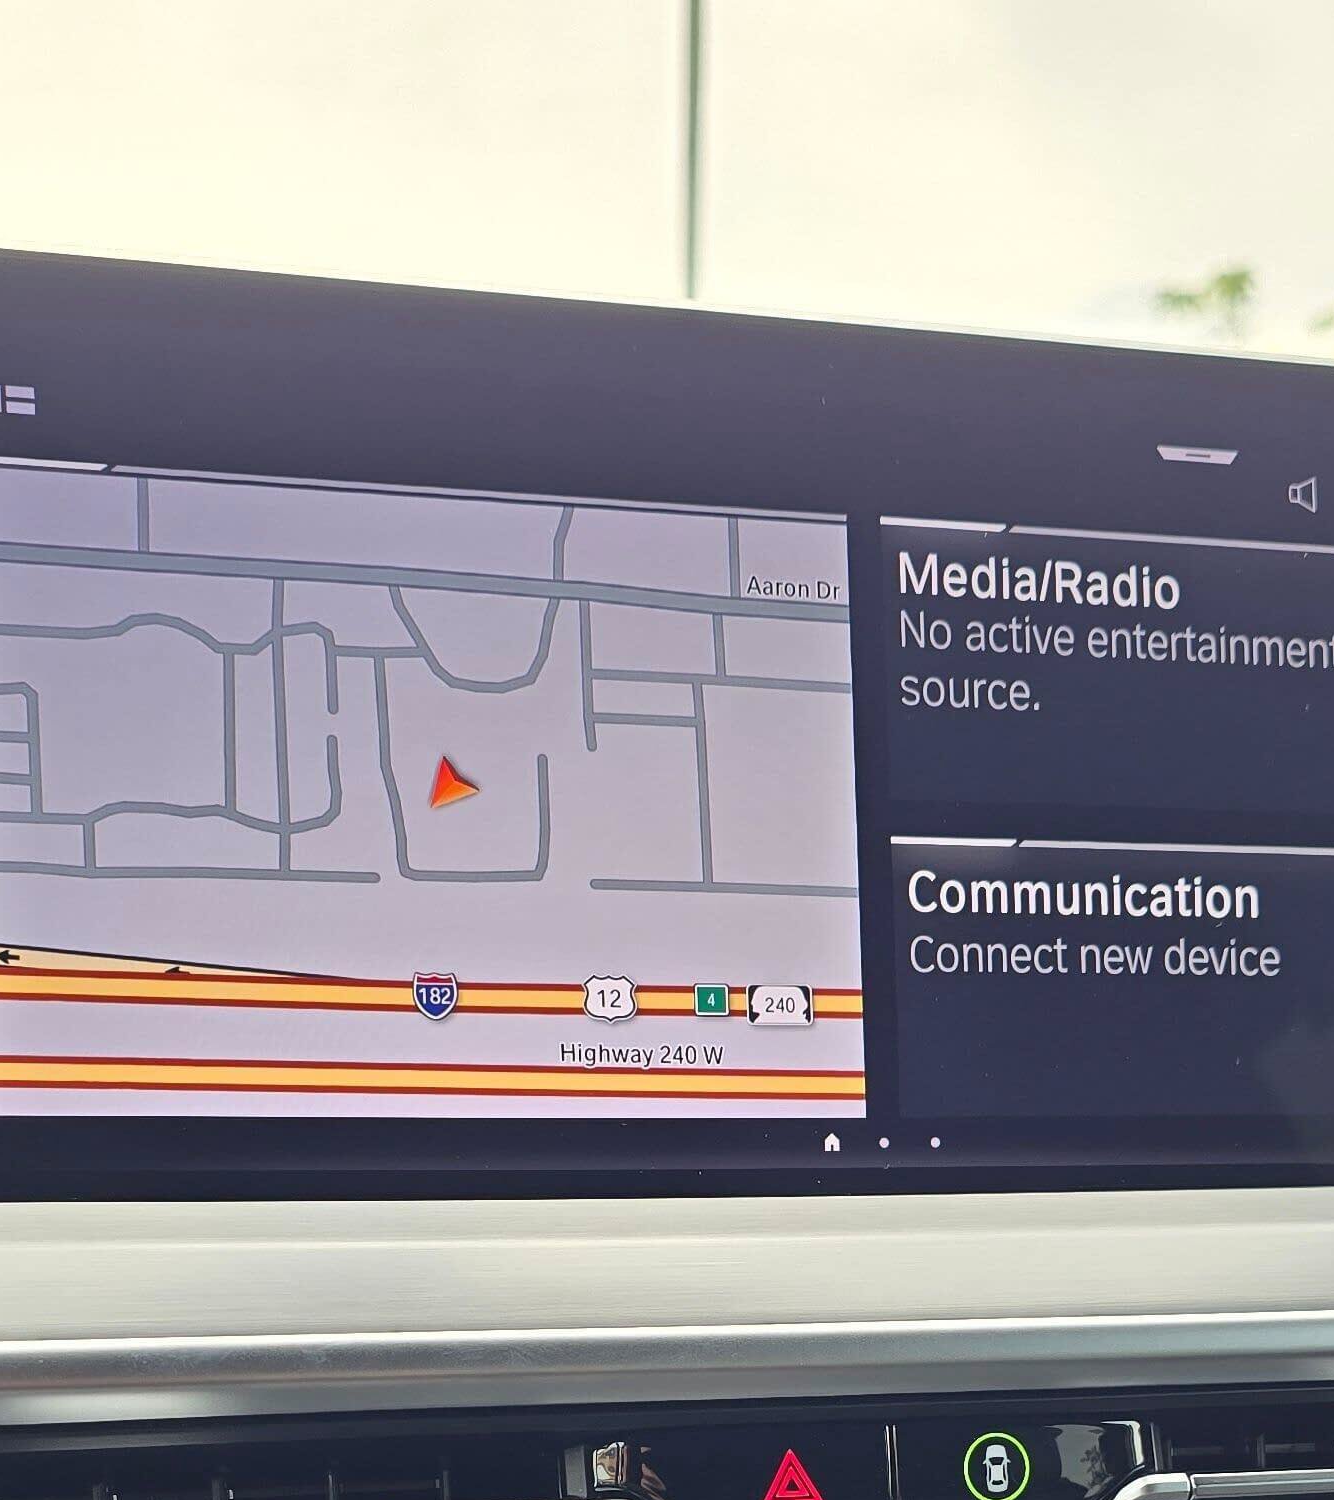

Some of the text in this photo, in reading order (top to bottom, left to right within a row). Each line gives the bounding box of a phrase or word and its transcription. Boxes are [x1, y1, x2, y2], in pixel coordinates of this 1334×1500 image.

[746, 575, 840, 601] Aaron Dr
[898, 551, 1181, 611] Media/Radio
[899, 610, 953, 651] No
[964, 613, 1075, 657] active
[899, 673, 1041, 712] source.
[907, 869, 1260, 921] Communication
[909, 935, 1282, 978] Connect new device
[417, 985, 452, 1007] 182
[596, 988, 622, 1011] 12
[706, 992, 717, 1008] 4
[764, 995, 797, 1016] 240
[559, 1042, 724, 1069] Highway 240 W
